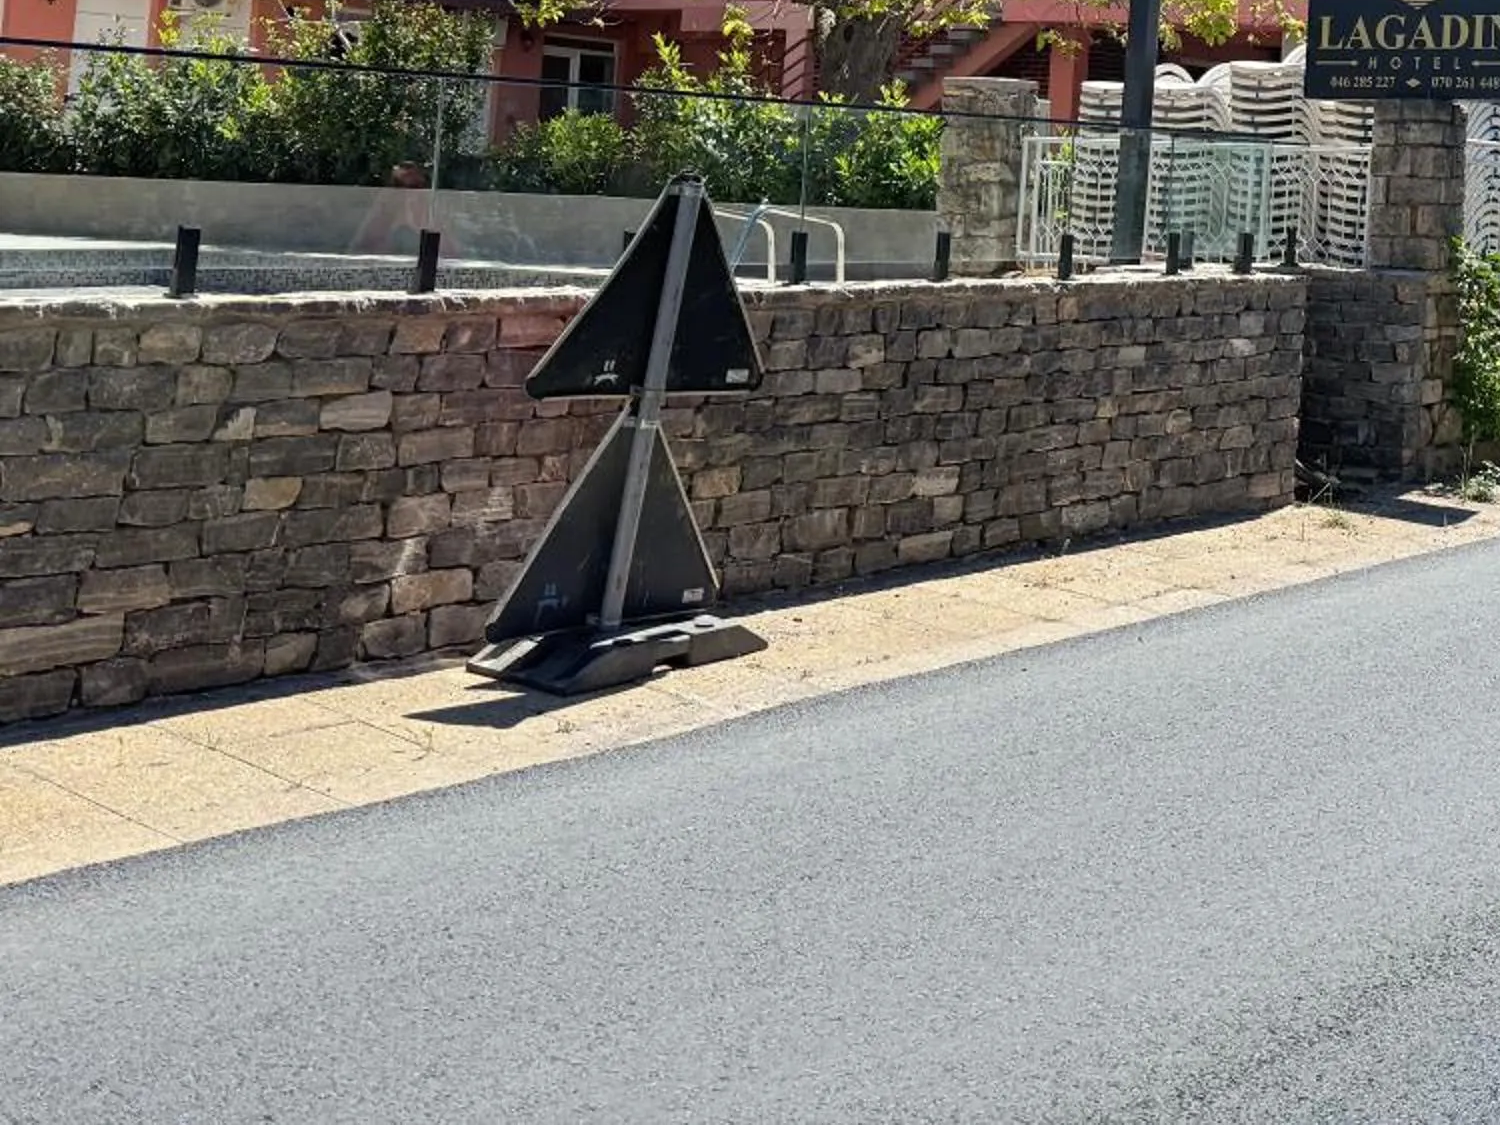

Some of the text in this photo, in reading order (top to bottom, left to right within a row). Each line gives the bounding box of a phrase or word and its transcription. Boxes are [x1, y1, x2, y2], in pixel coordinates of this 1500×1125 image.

[1368, 56, 1461, 70] HOTEL
[1330, 76, 1350, 88] 046
[1375, 76, 1396, 88] 227
[1431, 76, 1452, 88] 070
[1456, 76, 1475, 89] 261
